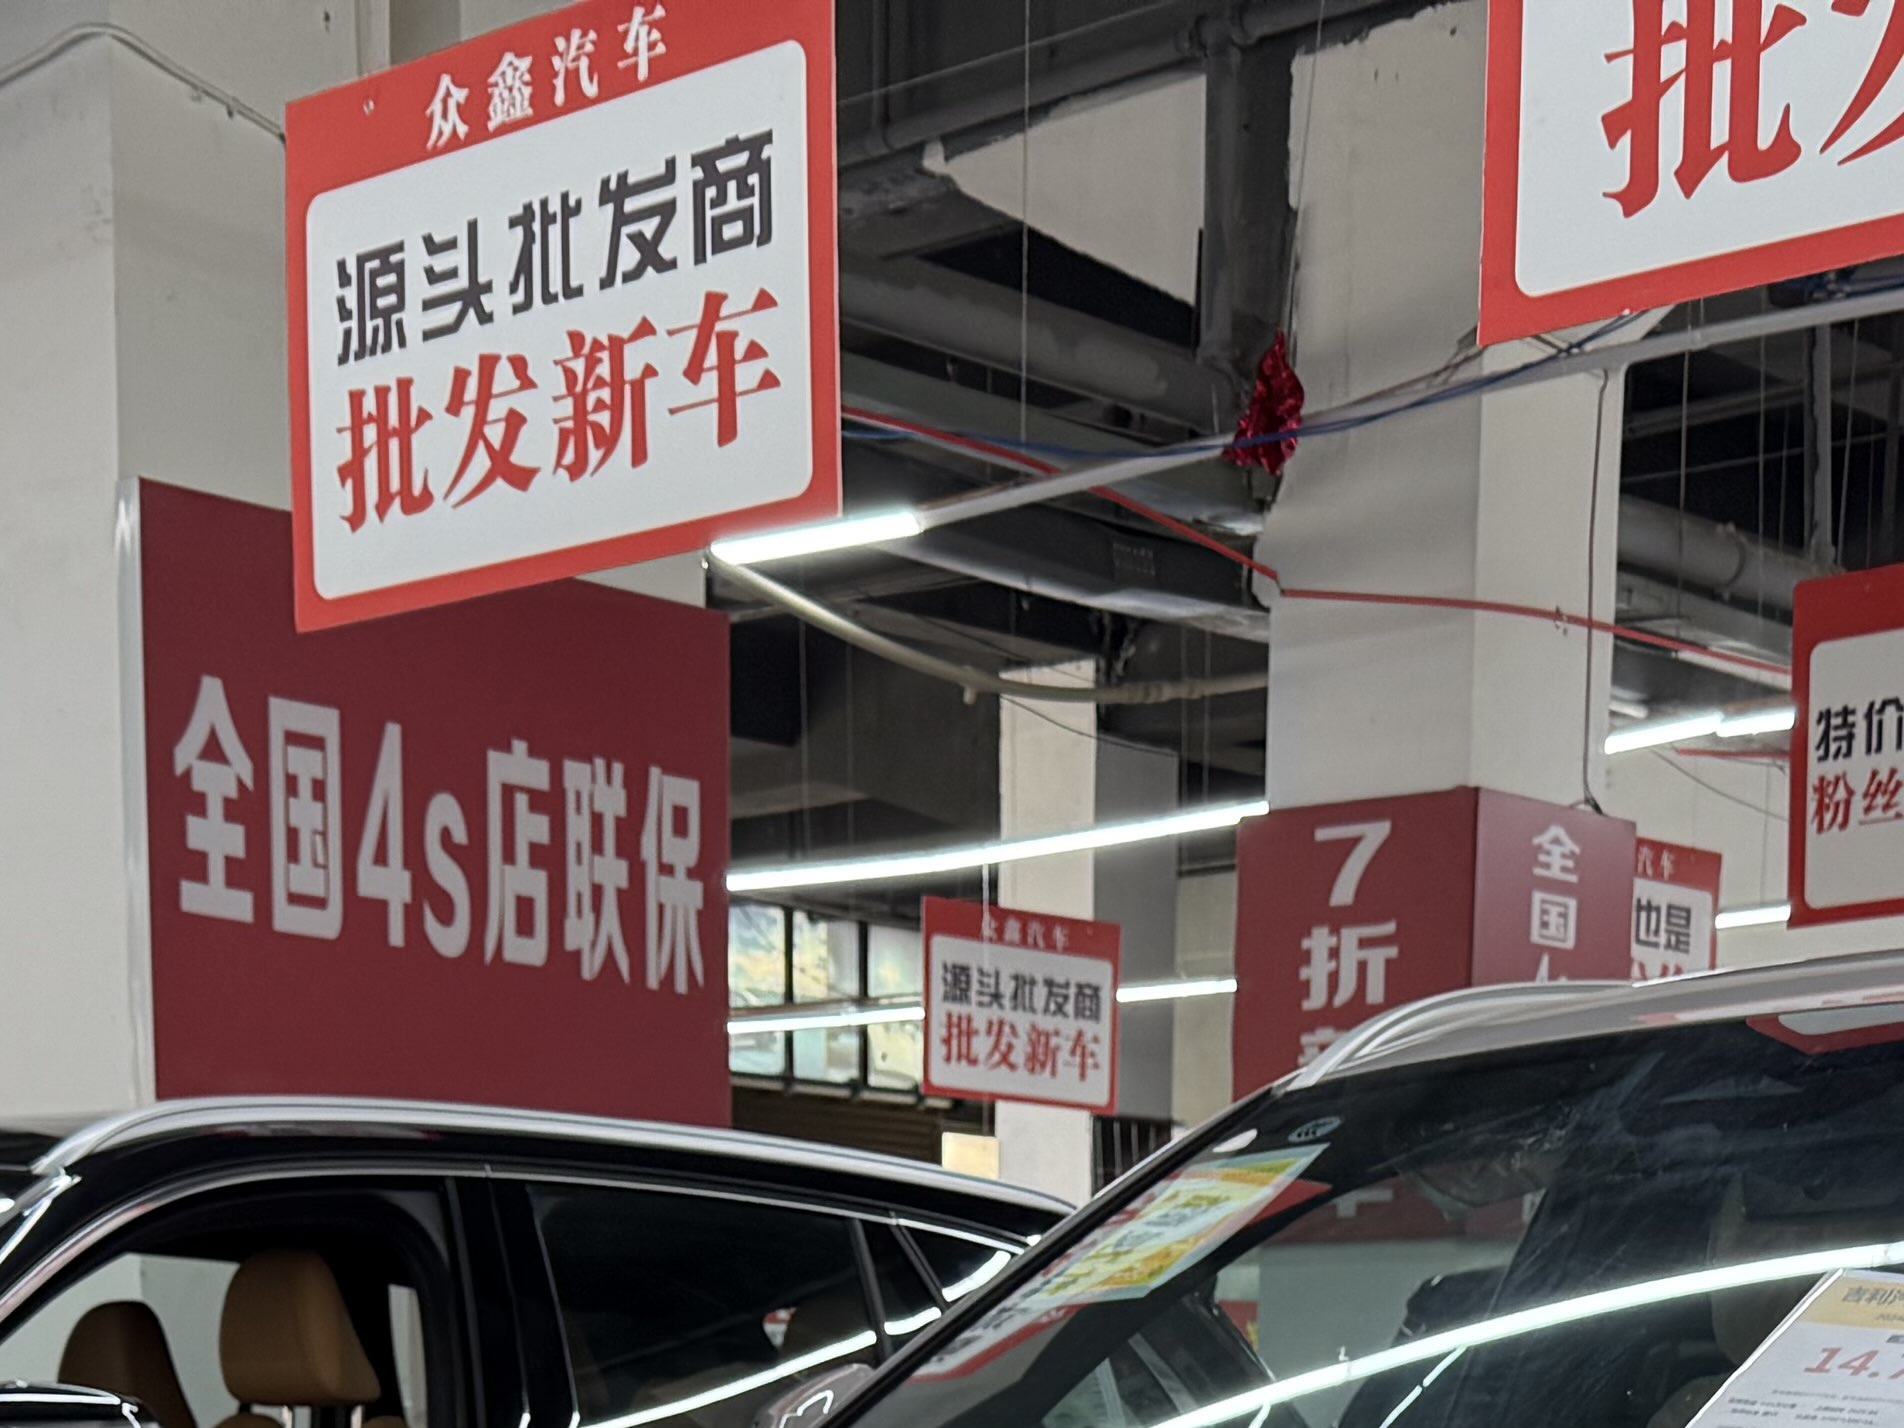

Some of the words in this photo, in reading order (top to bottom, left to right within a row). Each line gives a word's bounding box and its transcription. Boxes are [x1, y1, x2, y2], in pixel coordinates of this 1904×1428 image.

[424, 2, 668, 150] 众鑫汽车
[335, 129, 774, 366] 源头批发商
[335, 287, 781, 535] 批发新车
[173, 674, 704, 995] 全国4s店联保
[941, 962, 1101, 1024] 源头批发商
[1635, 896, 1692, 955] 也是
[940, 1010, 1101, 1081] 批发新车
